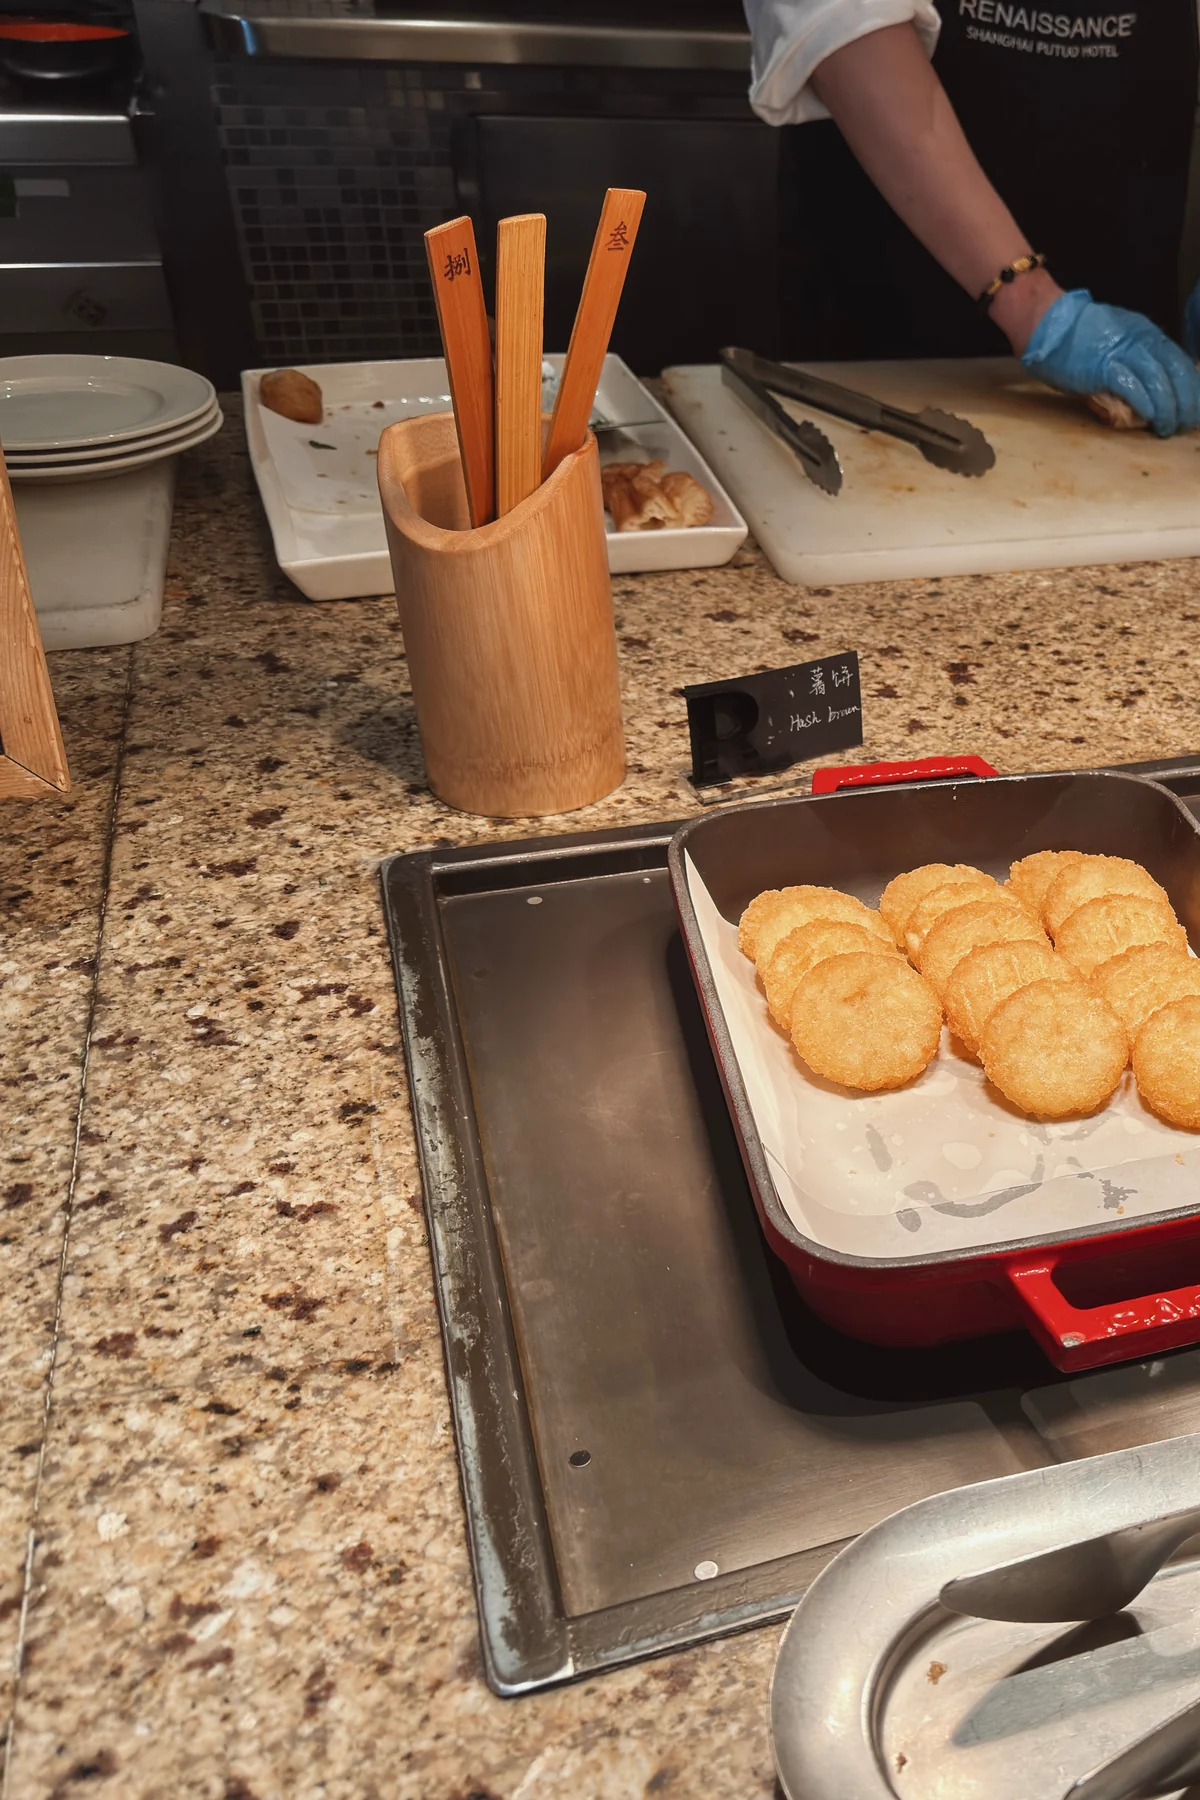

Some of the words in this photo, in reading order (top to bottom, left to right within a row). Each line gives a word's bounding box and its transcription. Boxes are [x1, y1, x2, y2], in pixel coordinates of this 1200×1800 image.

[958, 0, 1133, 38] RENAISSANCE
[966, 26, 1033, 52] SHANGHAI
[444, 248, 471, 281] 捌
[809, 666, 854, 696] 薯饼
[790, 711, 821, 732] Hash
